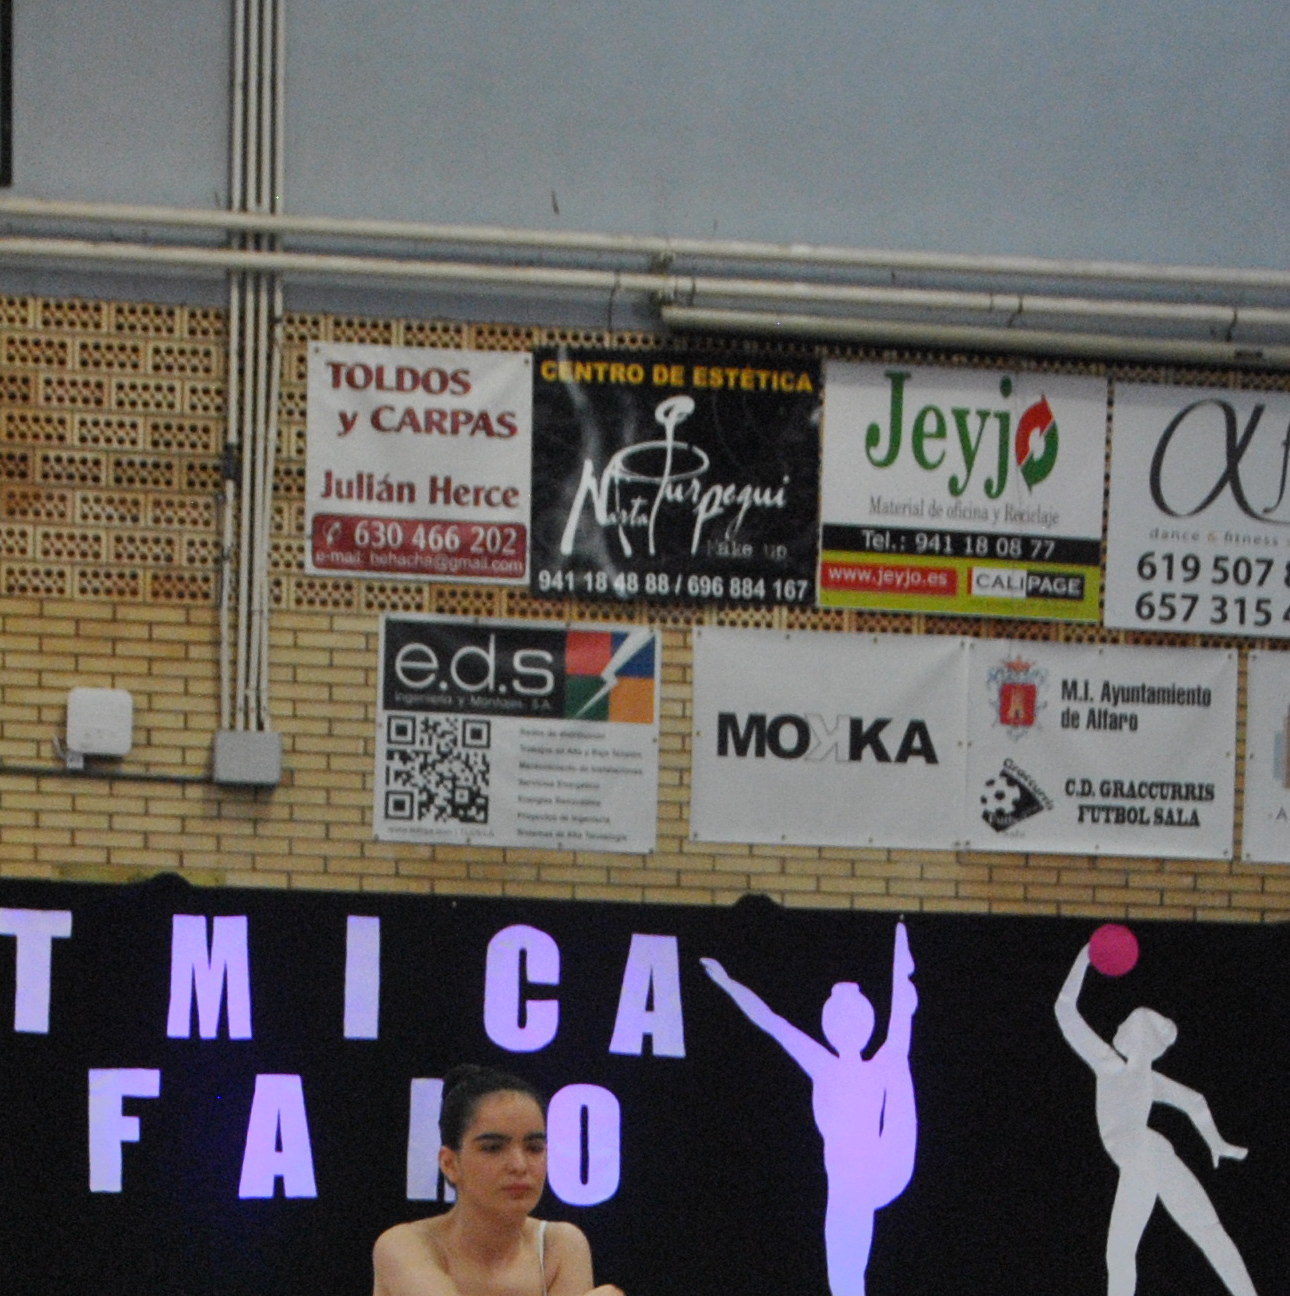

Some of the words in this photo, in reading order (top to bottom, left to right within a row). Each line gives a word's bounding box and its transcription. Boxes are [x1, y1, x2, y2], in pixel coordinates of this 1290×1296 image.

[327, 361, 472, 397] TOLDOS
[540, 360, 644, 384] CENTRO
[653, 364, 685, 386] DE
[337, 410, 358, 438] y
[370, 404, 518, 439] CARPAS
[321, 469, 416, 504] Julián
[429, 474, 520, 508] Herce
[869, 496, 924, 517] Material
[928, 500, 943, 518] de
[946, 500, 989, 521] oficina
[992, 508, 1000, 525] y
[1005, 503, 1059, 527] Reciclaje
[354, 520, 403, 548] 630
[412, 524, 460, 552] 466
[470, 526, 517, 555] 202
[862, 530, 905, 551] Tel.:
[915, 532, 953, 554] 941
[965, 535, 988, 556] 18
[996, 537, 1022, 559] 08
[1030, 539, 1056, 560] 77
[1149, 528, 1199, 543] dance
[1224, 531, 1279, 547] fitness
[538, 569, 575, 592] 941
[583, 570, 608, 593] 18
[613, 571, 639, 594] 48
[645, 572, 670, 595] 88
[687, 574, 724, 598] 696
[729, 577, 766, 599] 884
[772, 578, 808, 600] 167
[828, 566, 948, 588] www.jeyjo.es
[1137, 552, 1201, 582] 619
[1211, 555, 1274, 587] 507
[1135, 591, 1199, 622] 657
[1210, 595, 1273, 627] 315
[1061, 679, 1094, 702] M.I.
[1100, 680, 1212, 707] Ayuntamiento
[1061, 708, 1080, 729] de
[1086, 708, 1138, 731] Alfaro
[1065, 778, 1095, 798] C.D.
[1099, 779, 1215, 802] GRACCURRIS
[1077, 804, 1150, 826] FUTBOL
[1153, 807, 1200, 828] SALA
